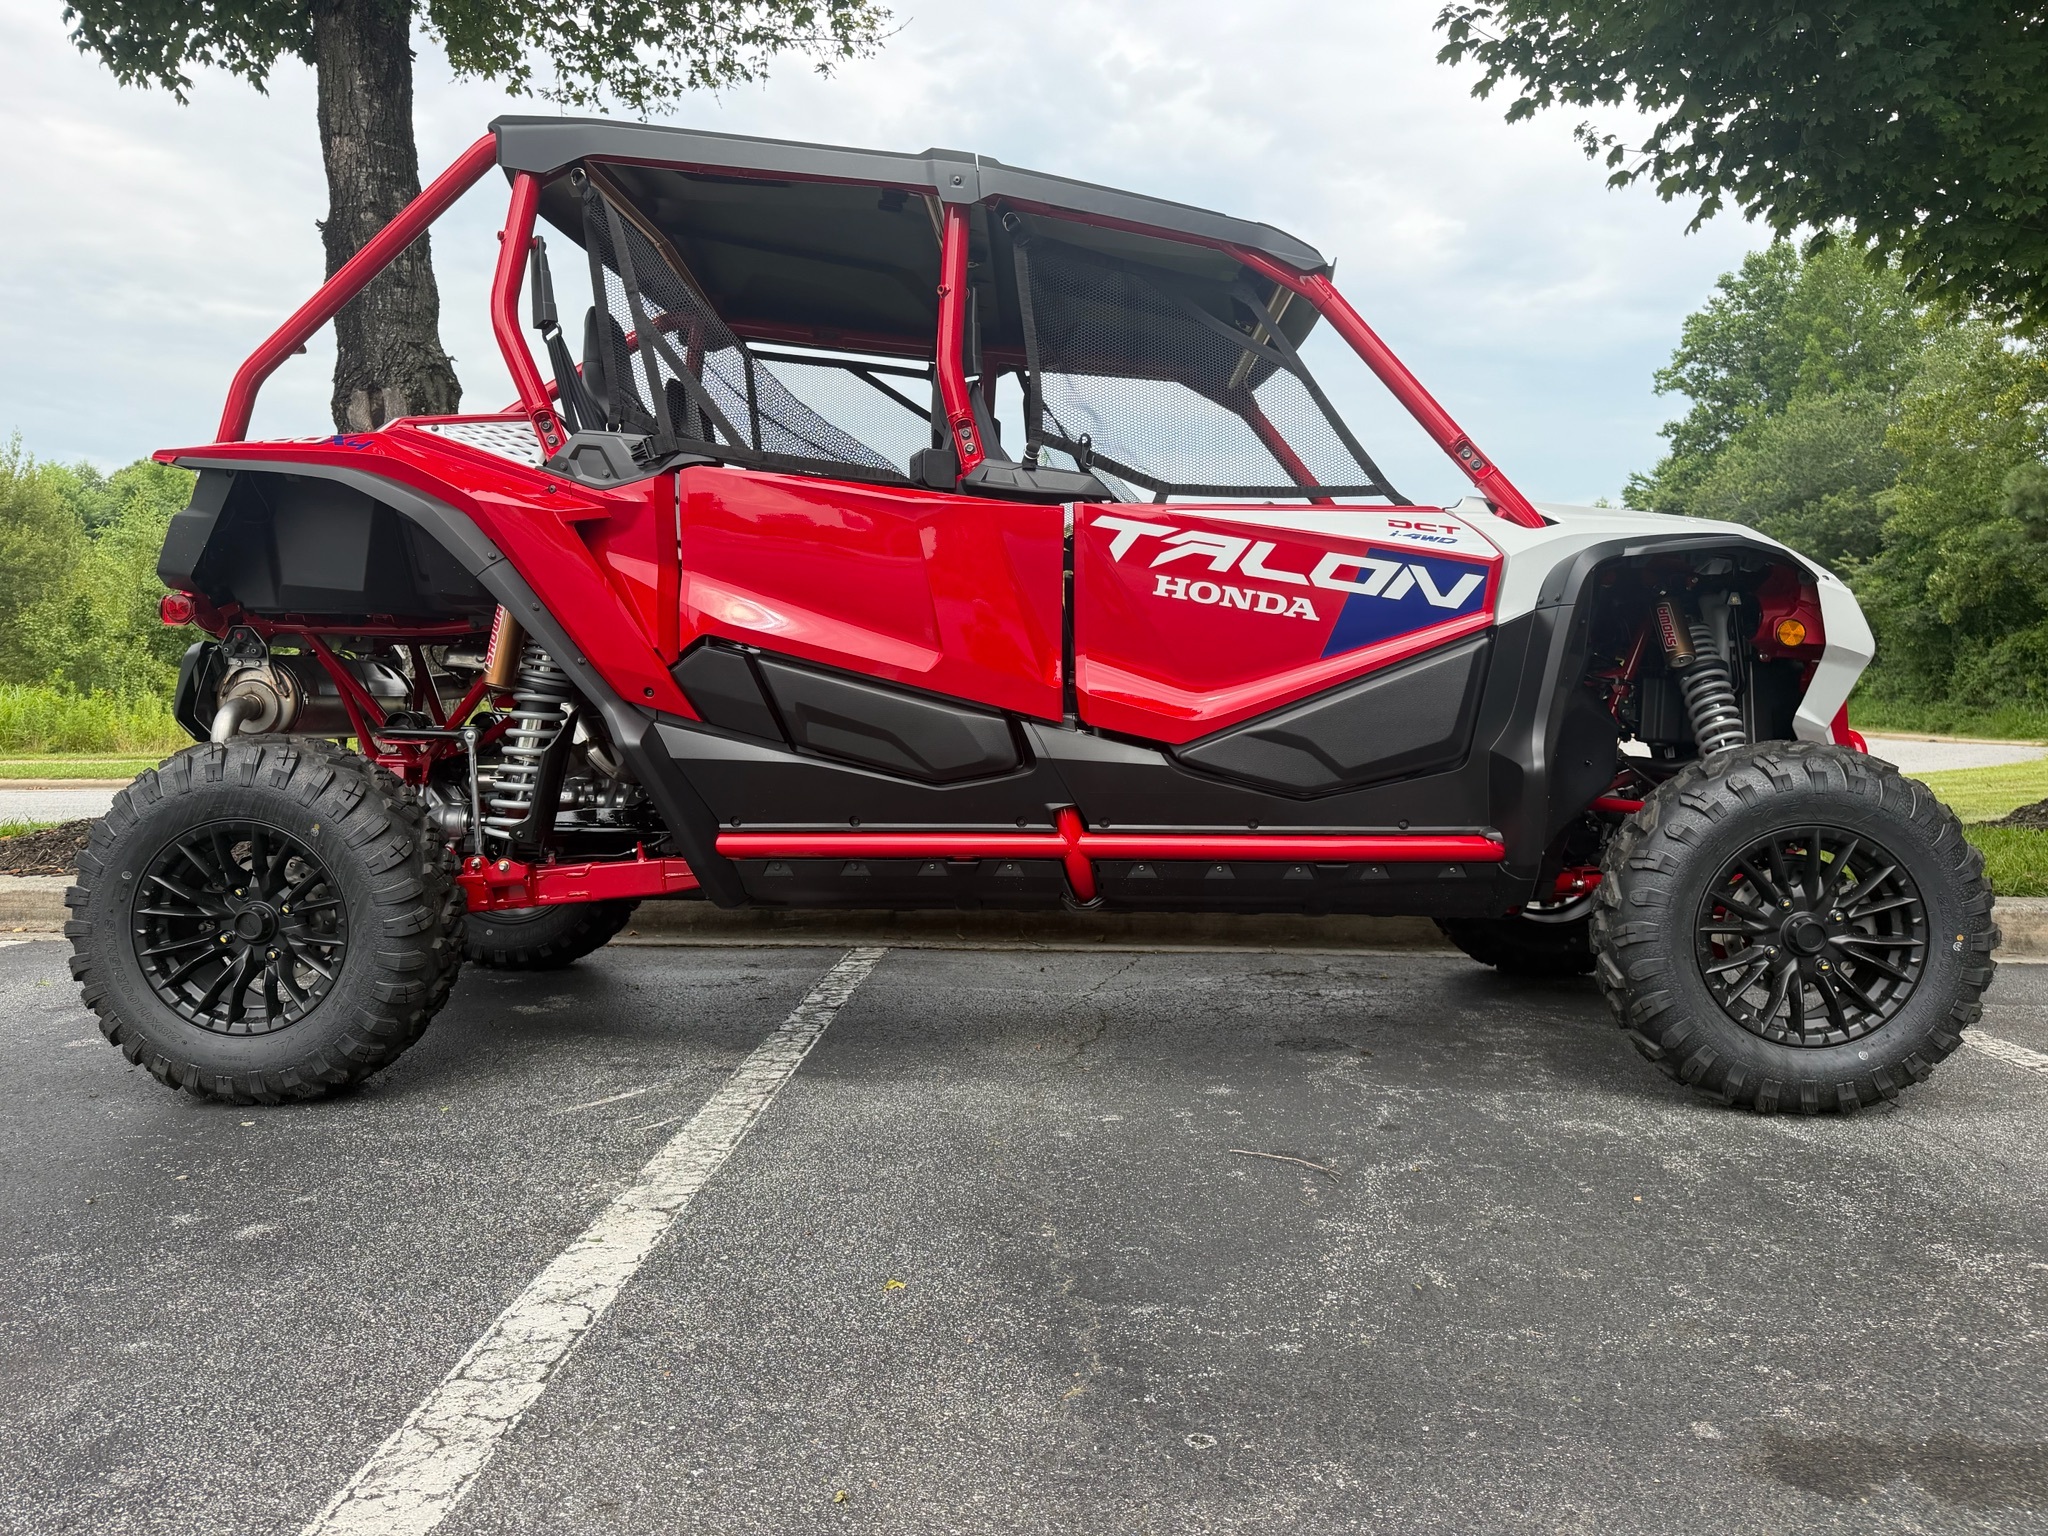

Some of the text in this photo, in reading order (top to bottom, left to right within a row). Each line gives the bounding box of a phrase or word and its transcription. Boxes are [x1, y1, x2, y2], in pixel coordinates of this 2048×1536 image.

[1387, 519, 1461, 535] DCT
[1088, 514, 1486, 610] TALON
[1152, 574, 1320, 621] HONDA
[1656, 605, 1679, 648] SHOWA
